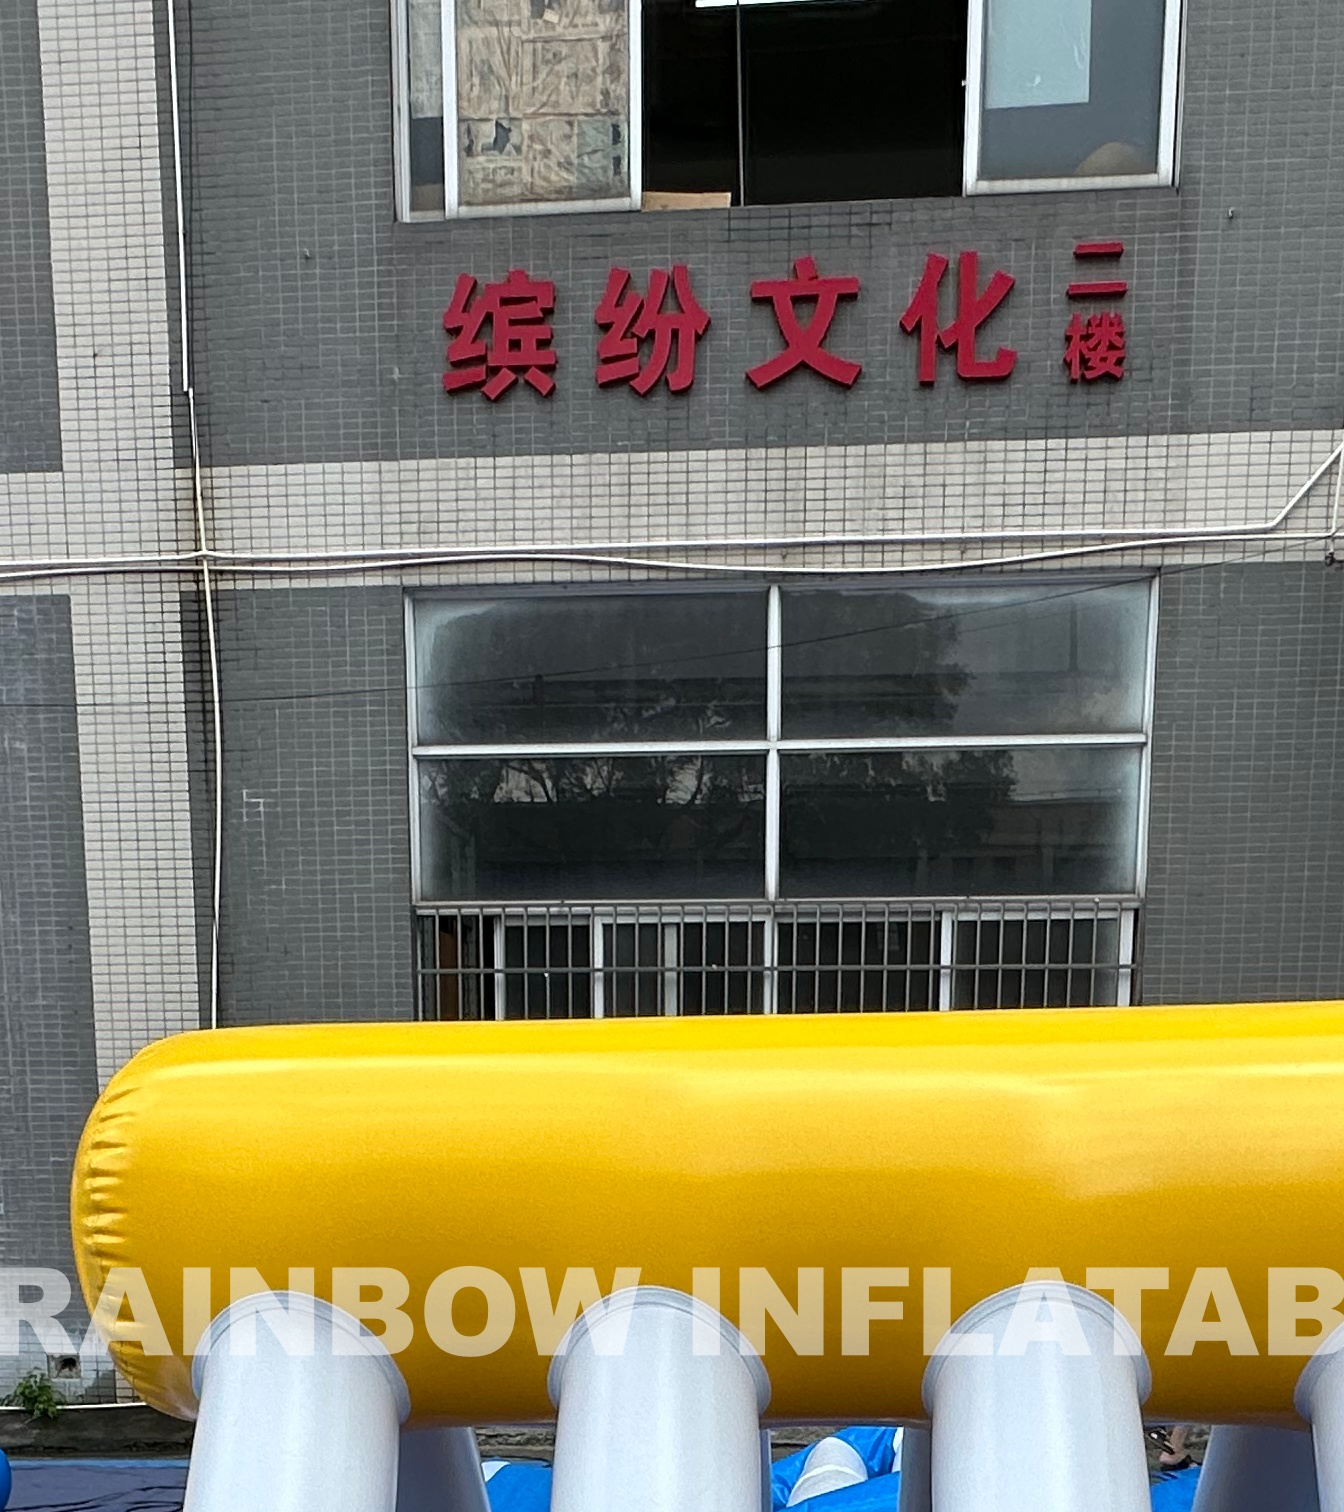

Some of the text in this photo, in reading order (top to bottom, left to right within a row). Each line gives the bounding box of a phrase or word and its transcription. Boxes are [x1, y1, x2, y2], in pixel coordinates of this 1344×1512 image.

[442, 250, 1018, 400] 缤纷文化
[1064, 241, 1129, 384] 二楼
